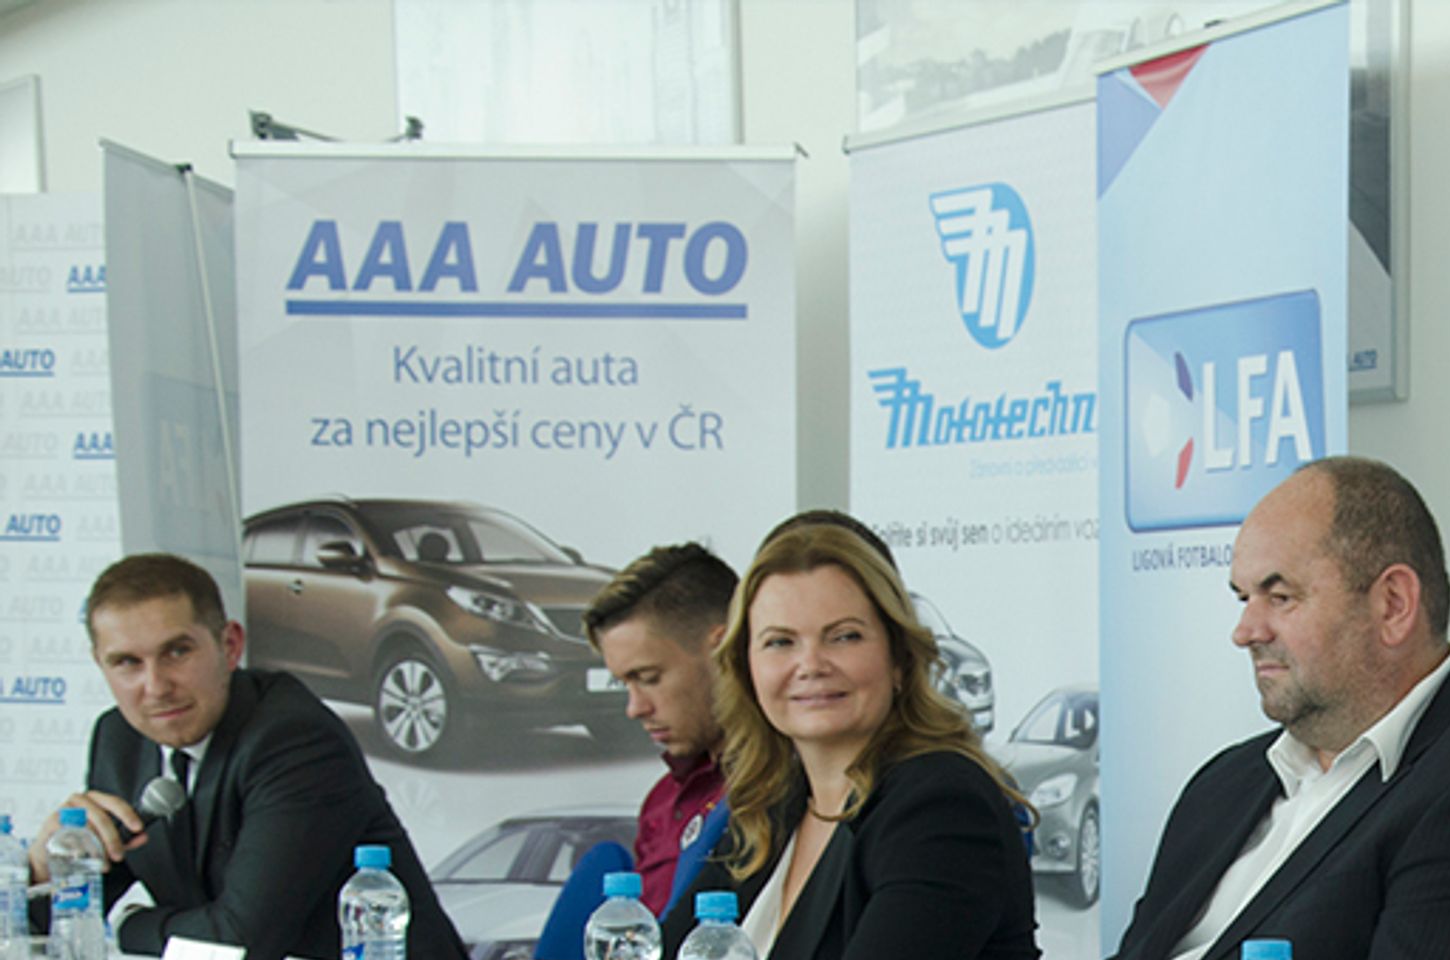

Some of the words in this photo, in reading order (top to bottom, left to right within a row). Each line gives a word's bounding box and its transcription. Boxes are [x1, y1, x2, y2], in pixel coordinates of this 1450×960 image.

[286, 220, 478, 292] AAA
[507, 221, 748, 294] AUTO
[394, 346, 539, 384] Kvalitní
[551, 353, 639, 386] auta
[311, 418, 353, 446] za
[366, 409, 519, 457] nejlepší
[531, 420, 625, 459] ceny
[635, 421, 658, 448] v
[669, 405, 724, 449] ČR
[868, 367, 1097, 449] Mototechn
[1203, 350, 1313, 469] LFA
